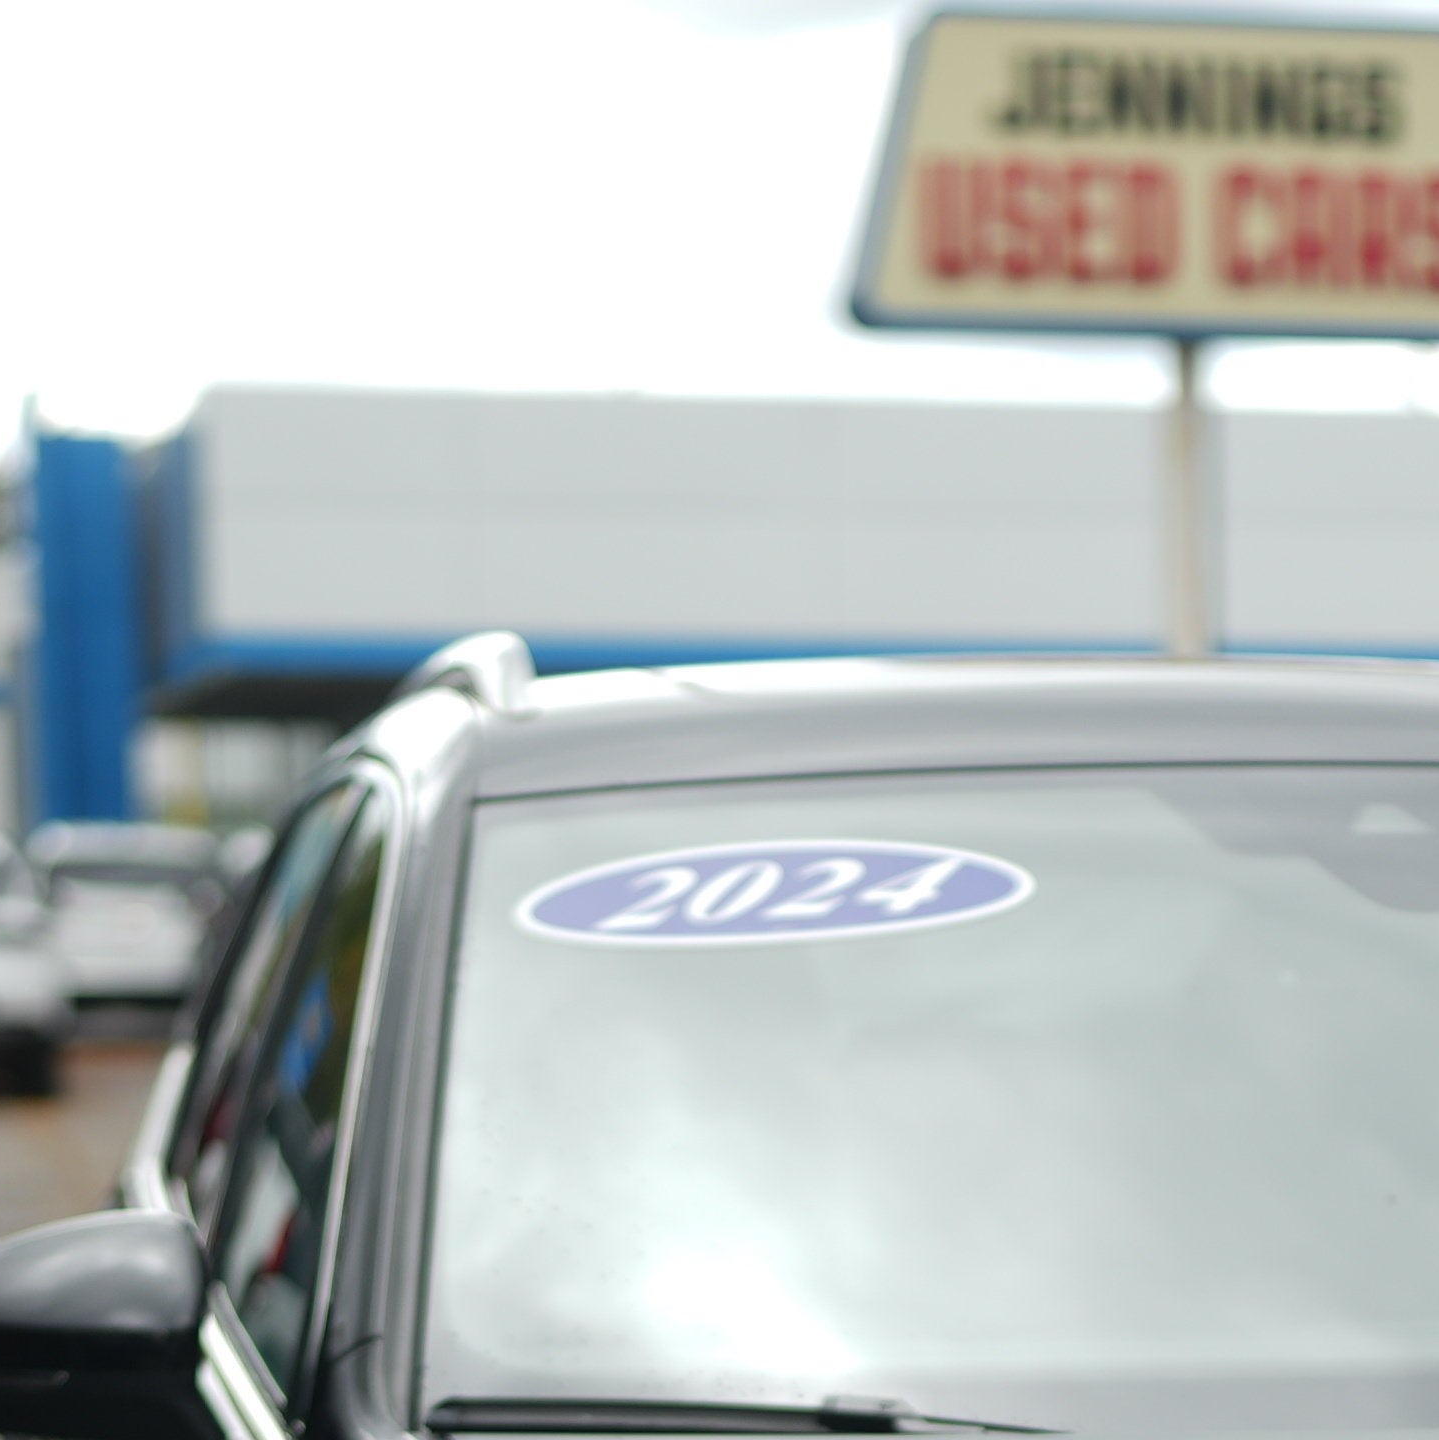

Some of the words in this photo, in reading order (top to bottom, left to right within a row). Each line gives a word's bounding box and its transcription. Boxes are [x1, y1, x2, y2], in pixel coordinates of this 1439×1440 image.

[993, 49, 1404, 143] JENNINGS
[919, 156, 1181, 285] USED
[592, 854, 967, 930] 2024
